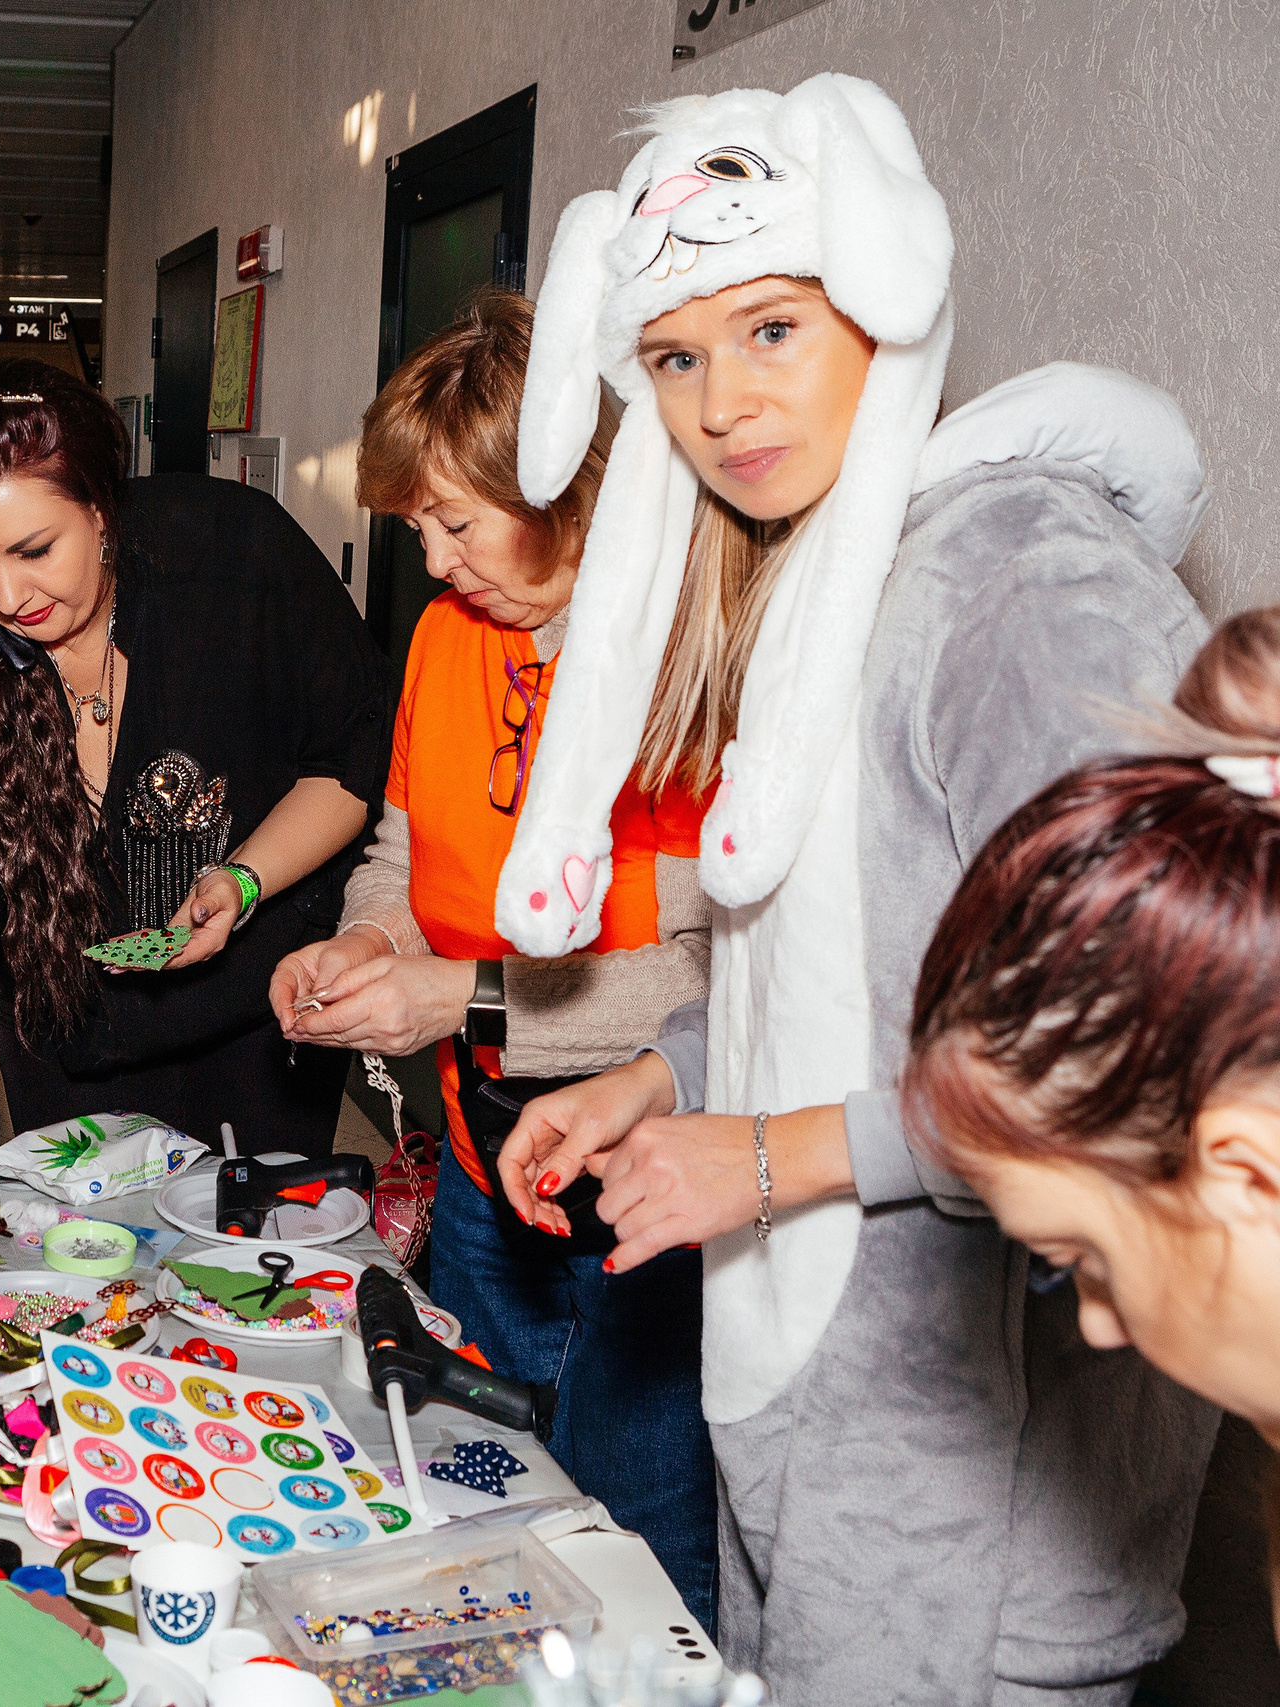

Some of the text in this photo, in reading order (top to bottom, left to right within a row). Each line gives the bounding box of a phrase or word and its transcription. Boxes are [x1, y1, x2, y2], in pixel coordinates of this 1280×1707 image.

[9, 304, 44, 314] 4 ЭТАЖ
[16, 322, 40, 337] P4
